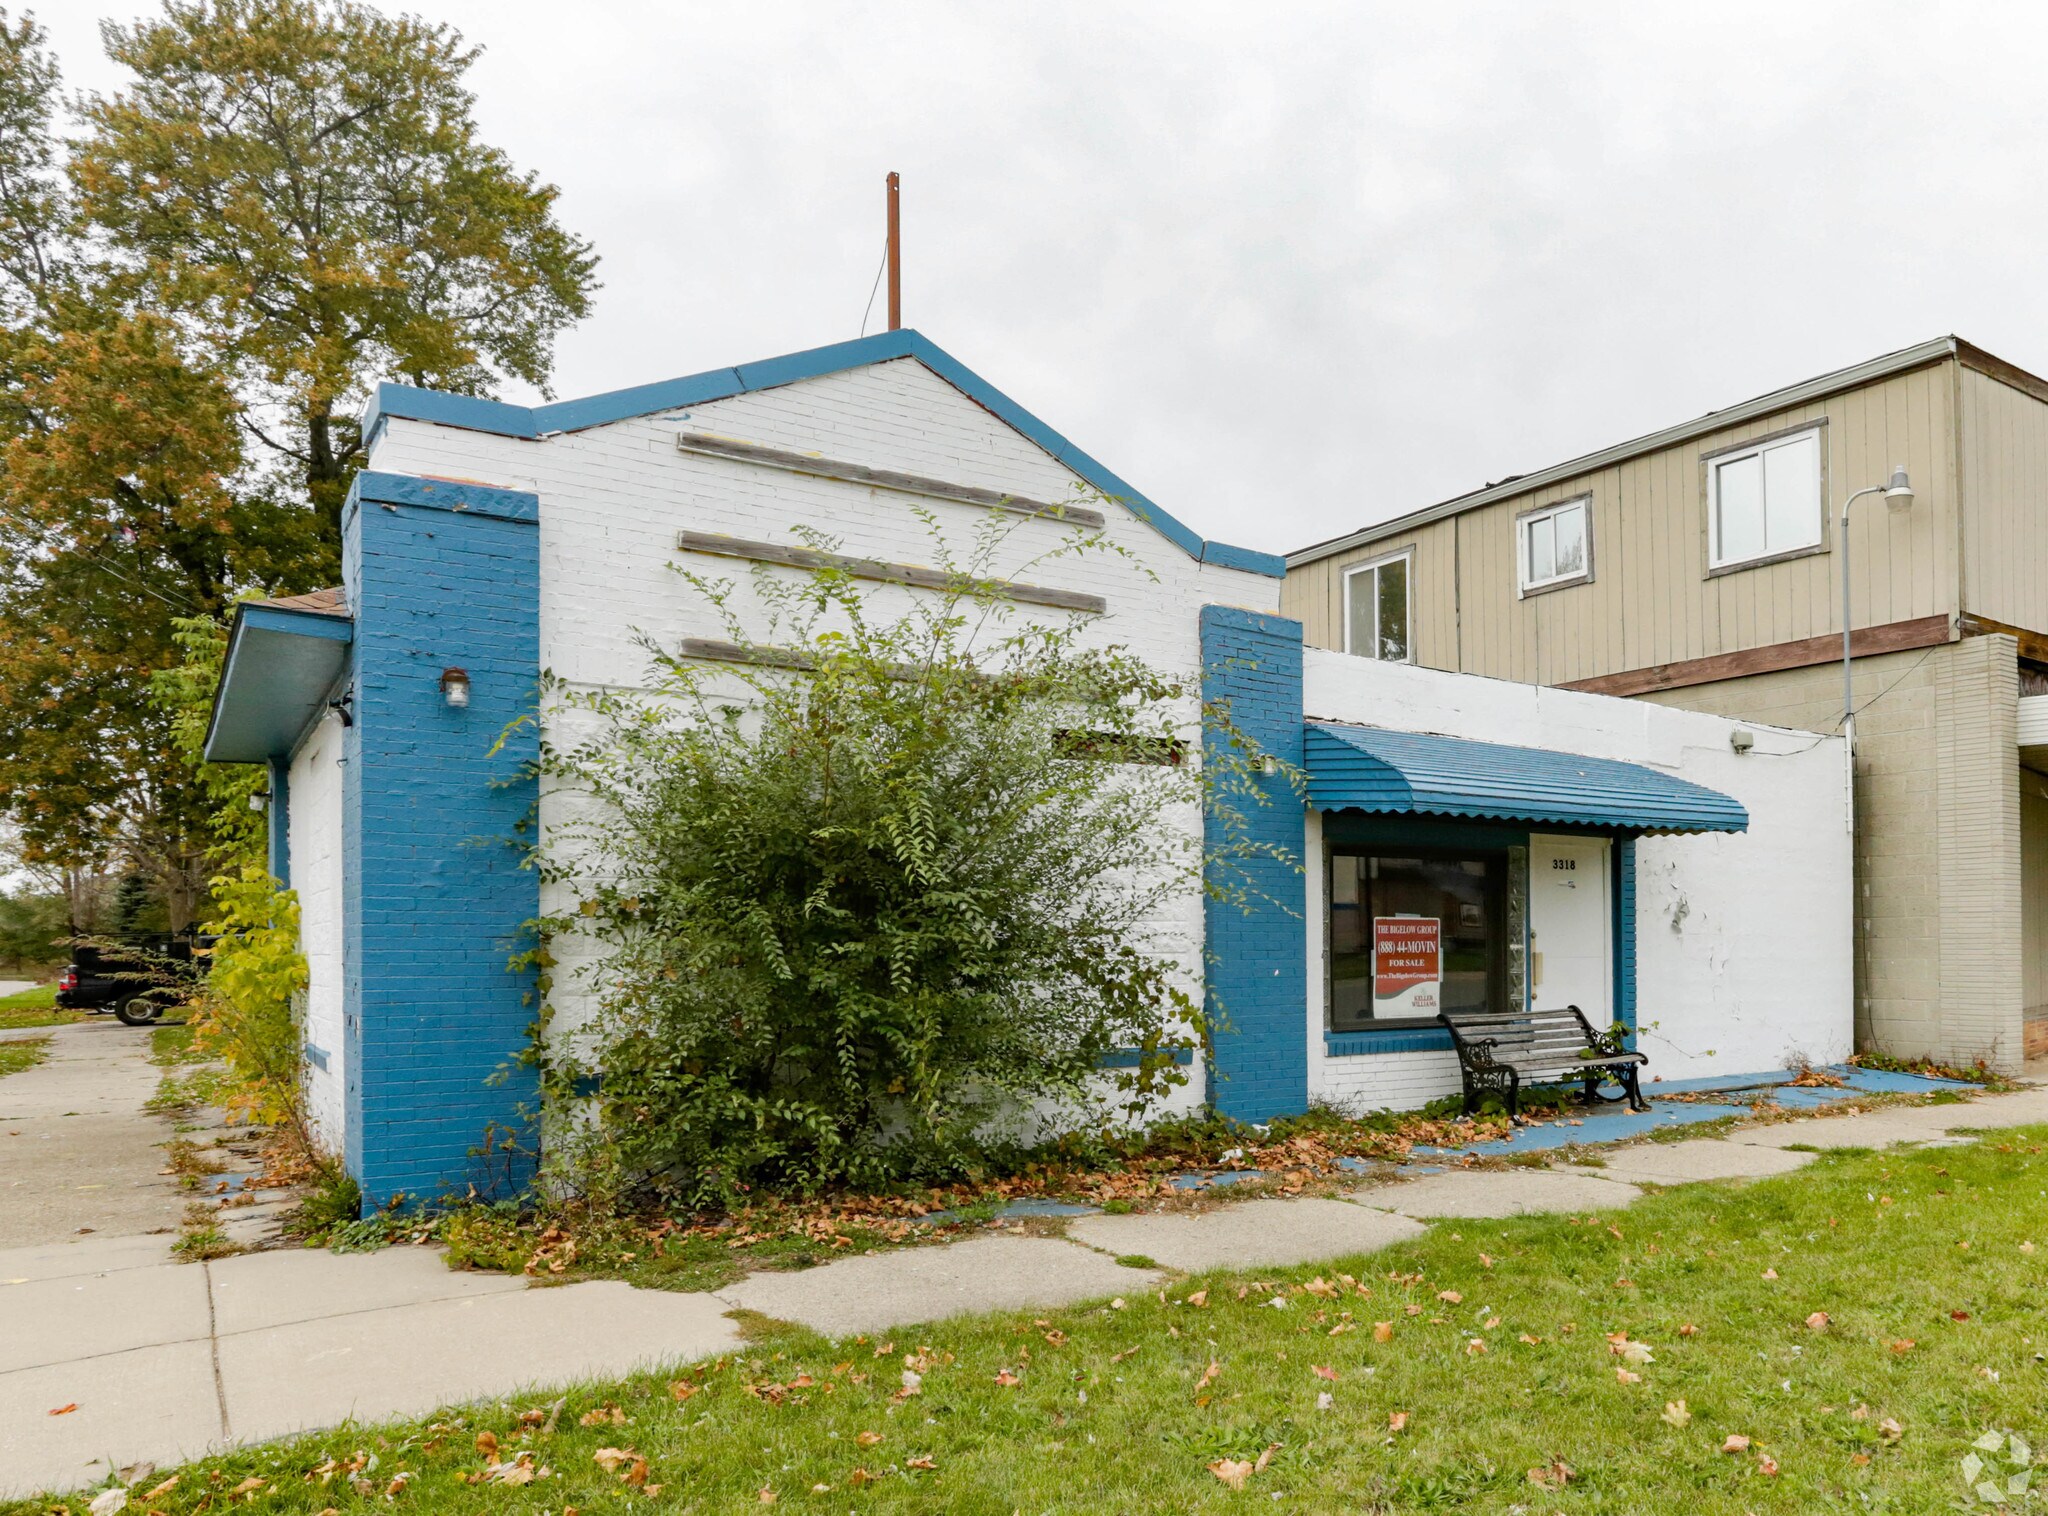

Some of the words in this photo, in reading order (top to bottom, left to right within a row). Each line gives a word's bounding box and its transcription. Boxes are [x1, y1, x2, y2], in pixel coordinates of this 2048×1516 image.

[1552, 859, 1576, 870] 3318
[1378, 925, 1389, 934] THE
[1389, 925, 1416, 934] BIGELOW
[1416, 925, 1437, 934] GROUP
[1378, 941, 1395, 954] (888)
[1396, 941, 1436, 953] 44-MOVIN
[1389, 959, 1405, 967] FOR
[1405, 959, 1425, 967] SALE
